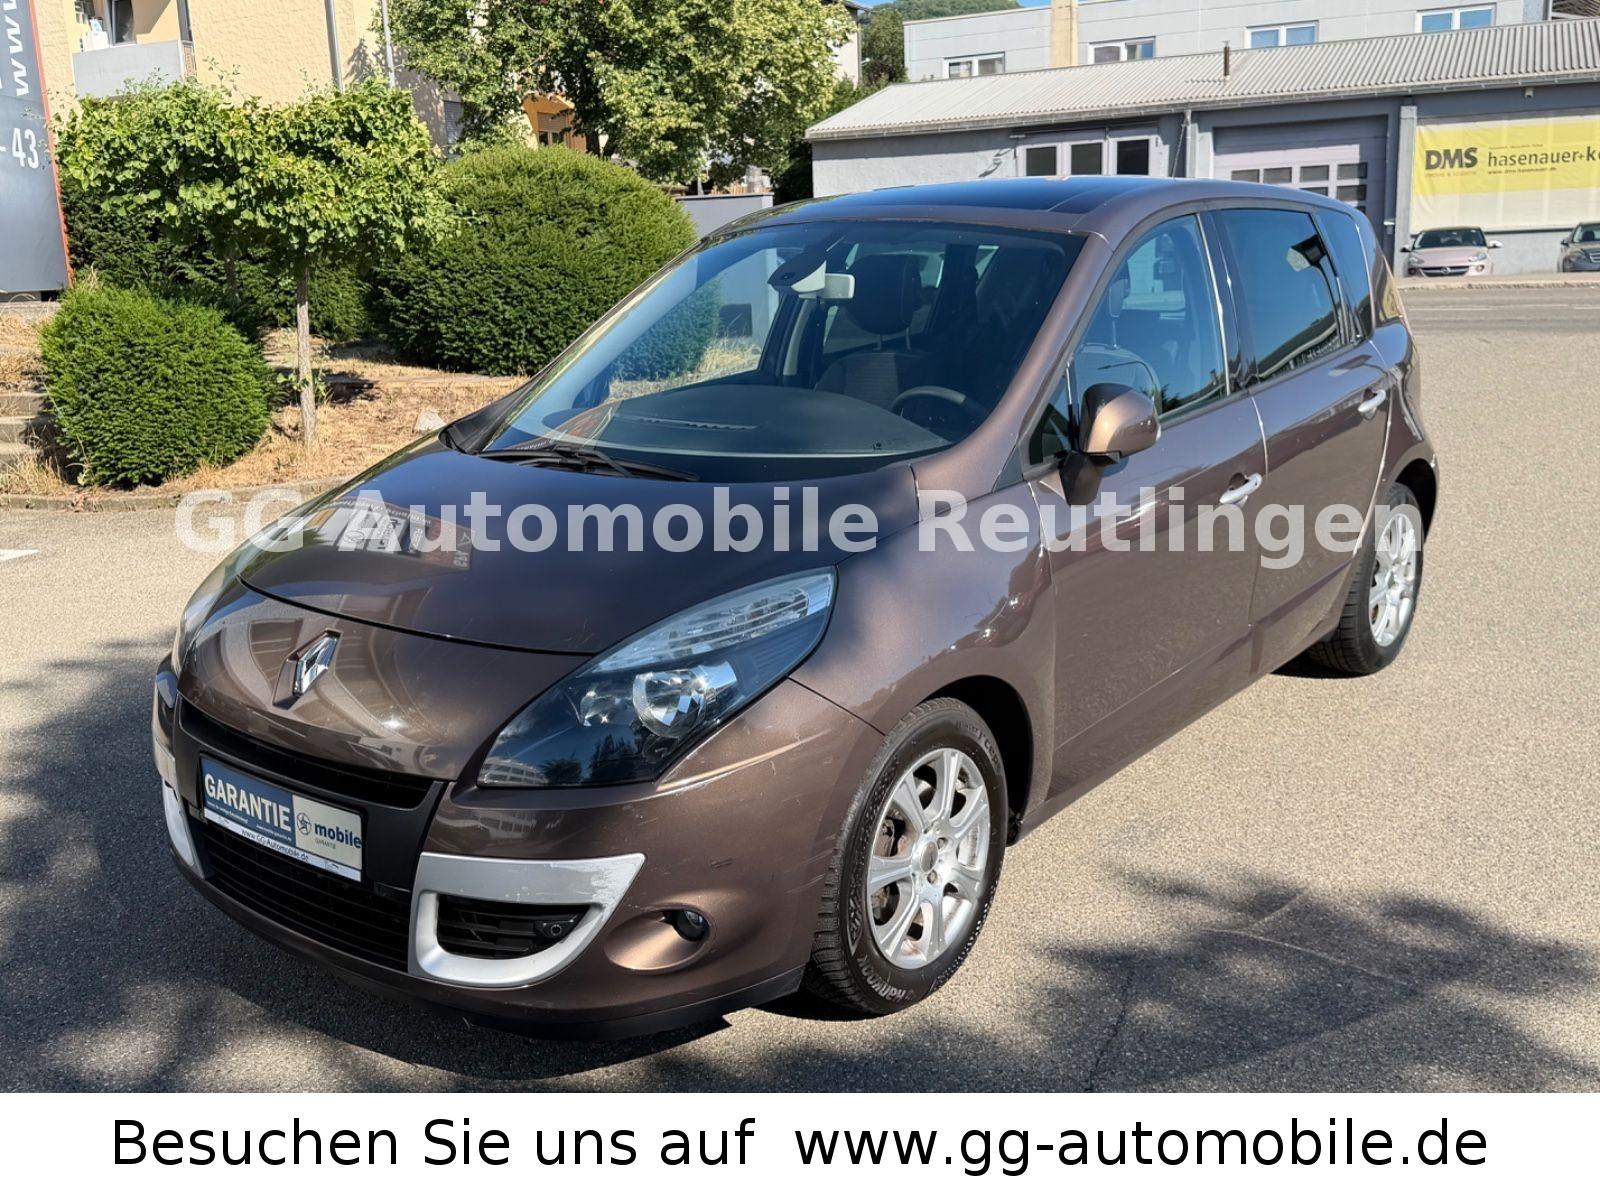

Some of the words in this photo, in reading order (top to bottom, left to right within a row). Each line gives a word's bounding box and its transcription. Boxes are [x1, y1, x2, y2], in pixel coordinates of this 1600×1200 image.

[1425, 147, 1478, 170] DMS
[1487, 145, 1600, 168] hasenauer+k
[204, 773, 292, 832] GARANTIE
[314, 821, 363, 849] mobile
